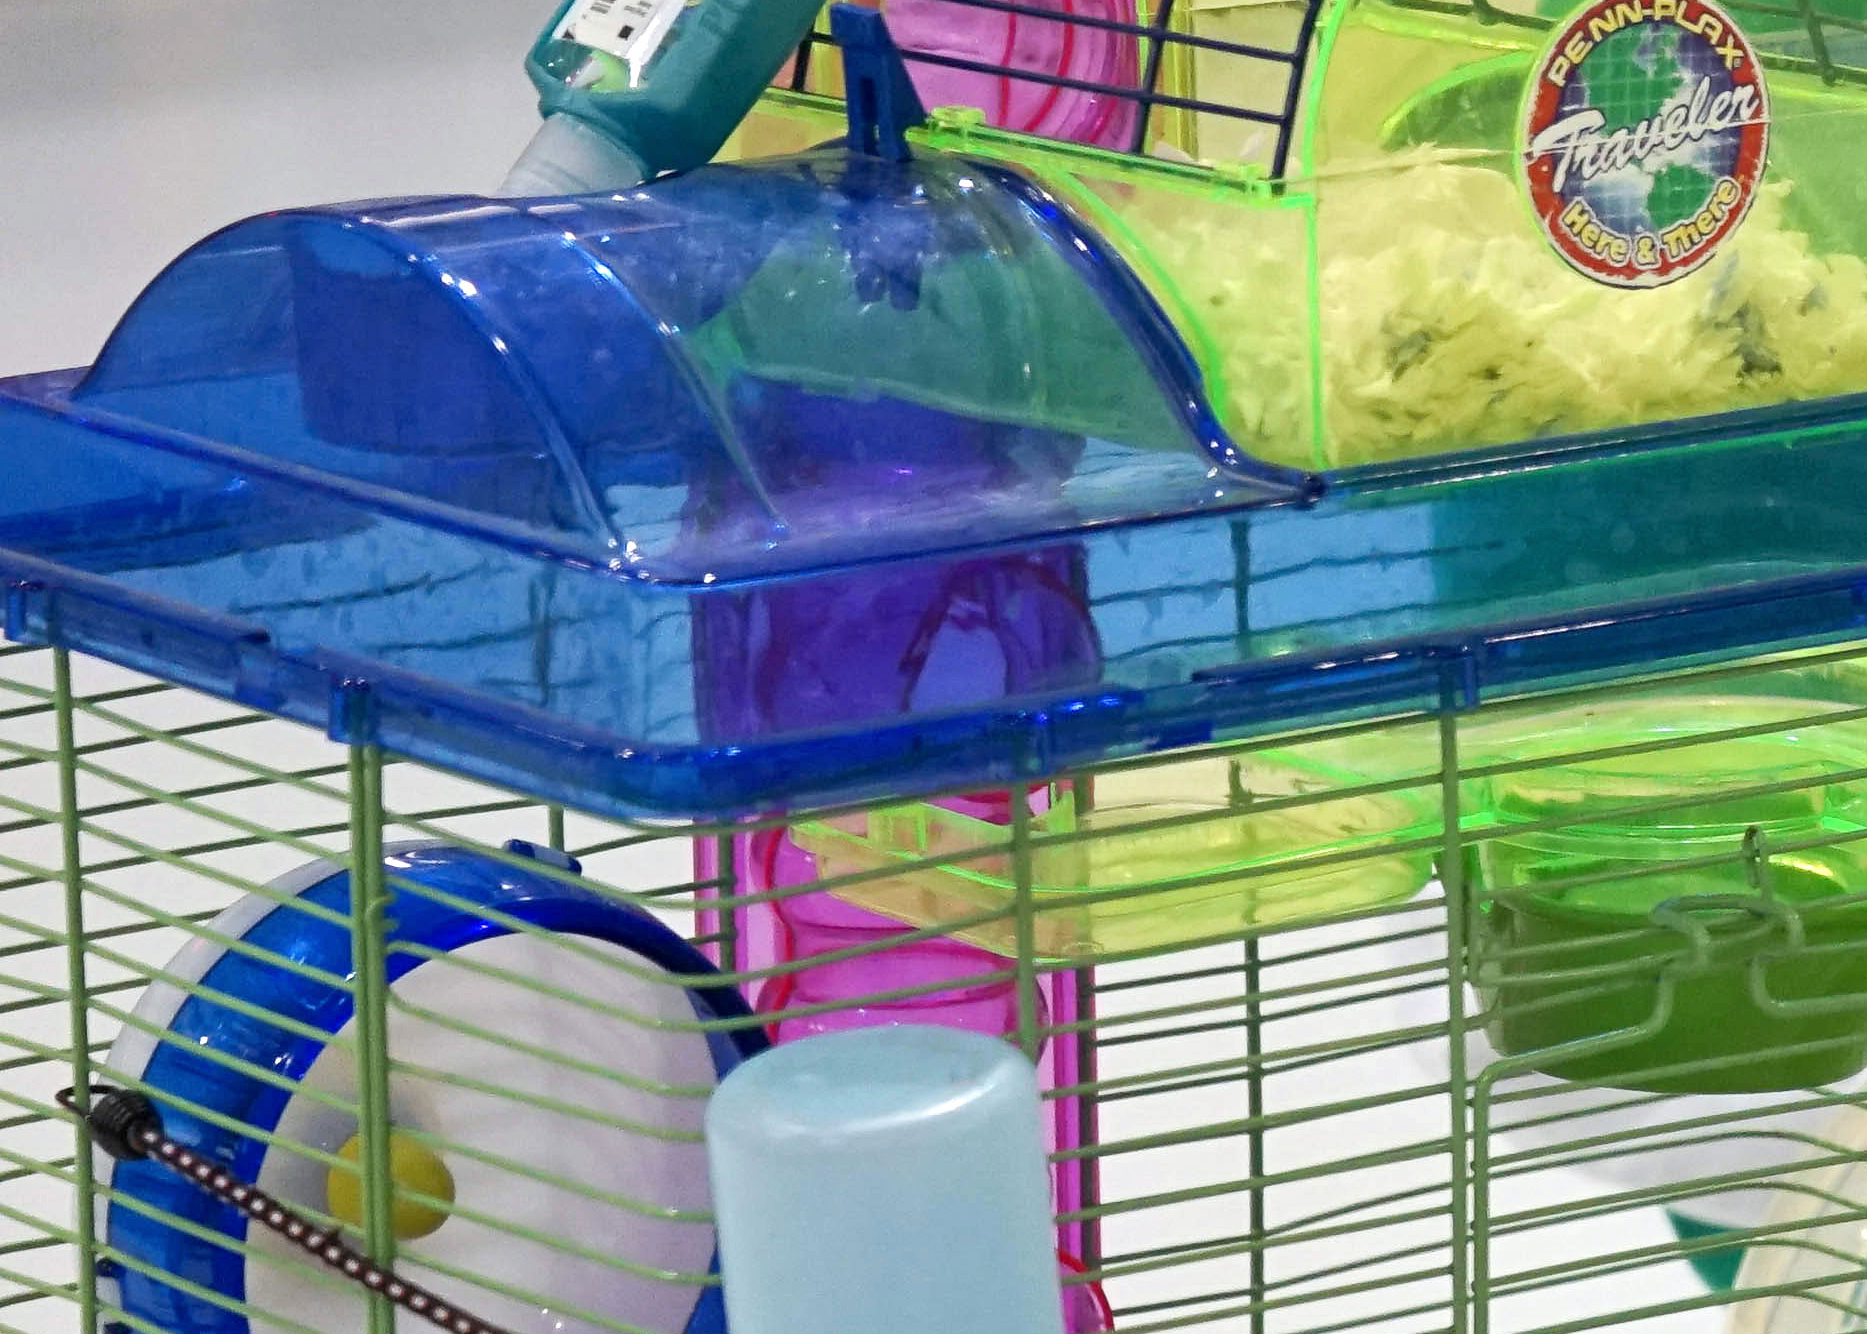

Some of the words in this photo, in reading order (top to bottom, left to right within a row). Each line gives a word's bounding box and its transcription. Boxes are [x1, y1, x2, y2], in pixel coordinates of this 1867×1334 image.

[1531, 75, 1761, 193] Traveler
[1562, 200, 1628, 264] Here
[1636, 235, 1659, 265] &
[1661, 179, 1740, 259] There
